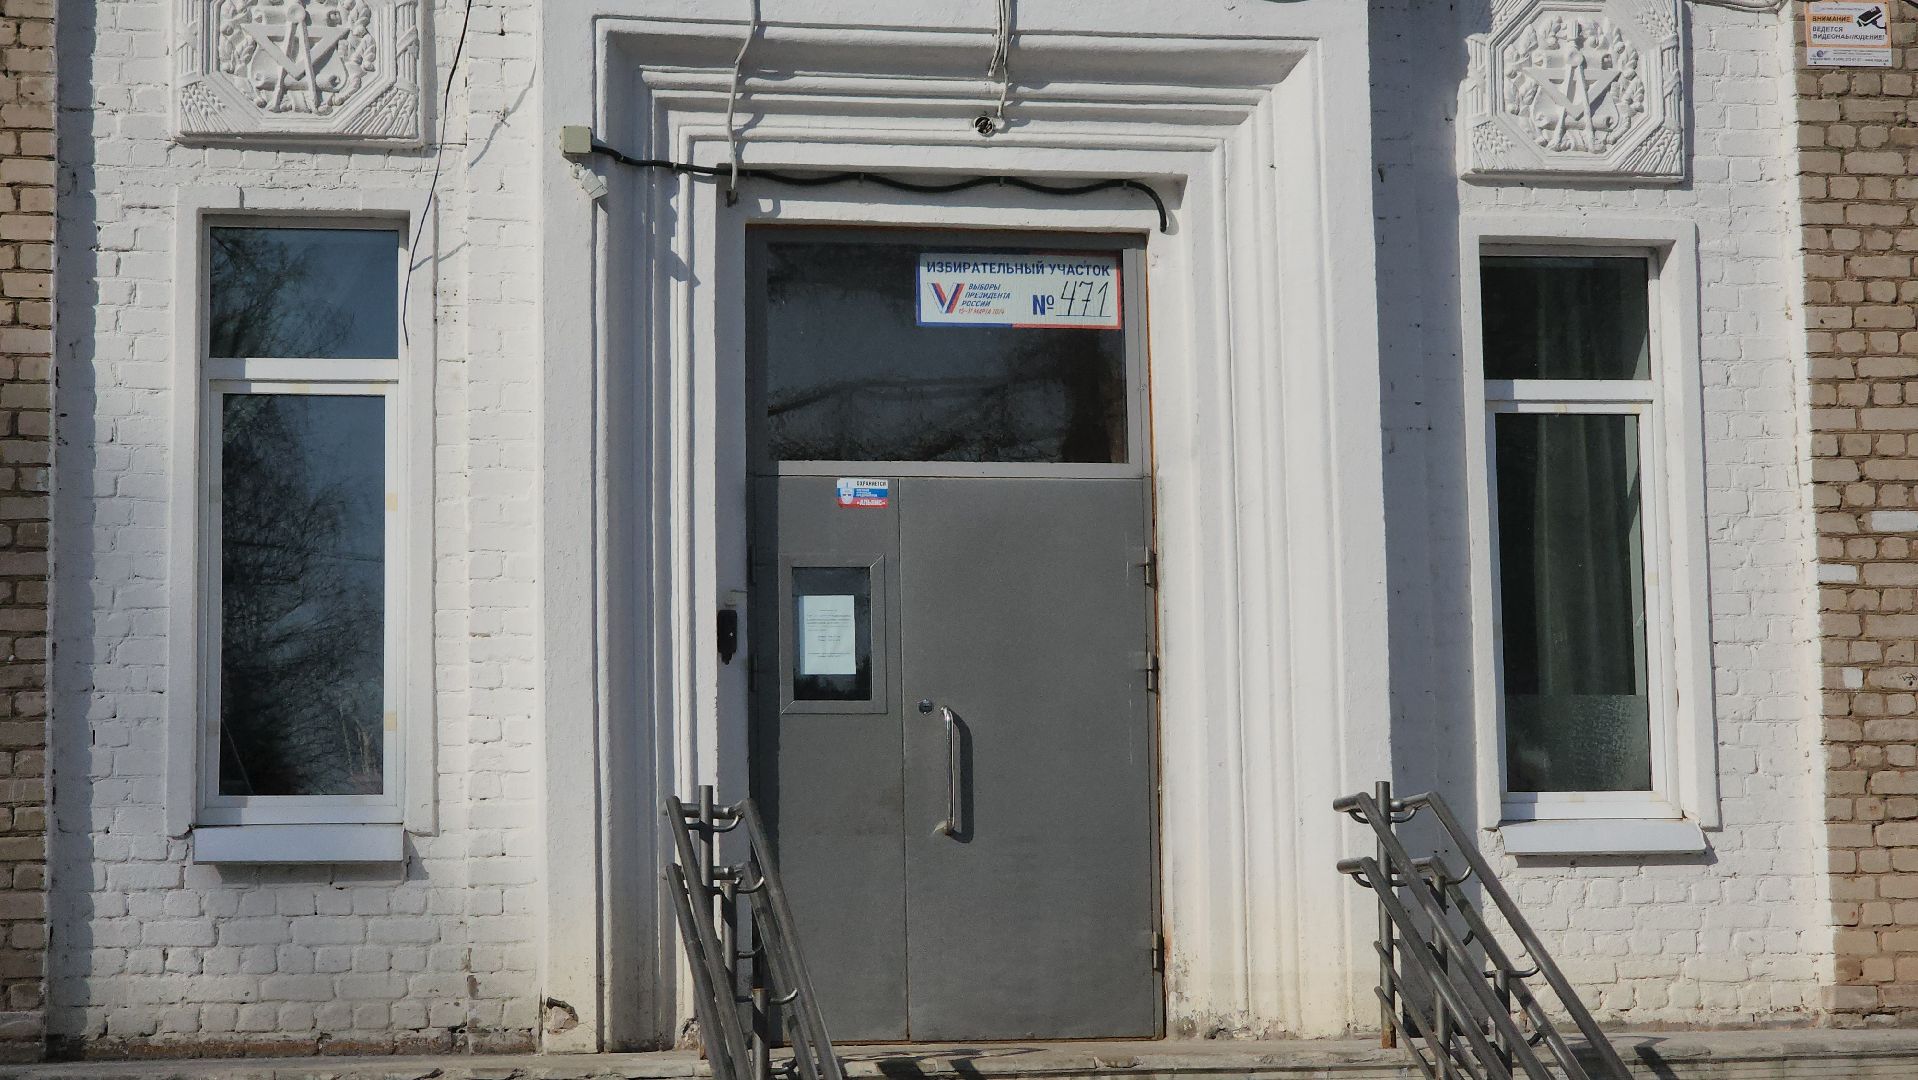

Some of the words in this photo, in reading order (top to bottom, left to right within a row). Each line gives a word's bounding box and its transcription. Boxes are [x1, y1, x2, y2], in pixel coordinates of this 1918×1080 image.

[927, 260, 1045, 275] ИЗБИРАТЕЛЬНЫЙ
[1050, 262, 1111, 277] УЧАСТОК
[968, 283, 1001, 291] ВЫБОРЫ
[965, 292, 1011, 300] ПРЕЗИДЕНТА
[1060, 280, 1109, 317] 471
